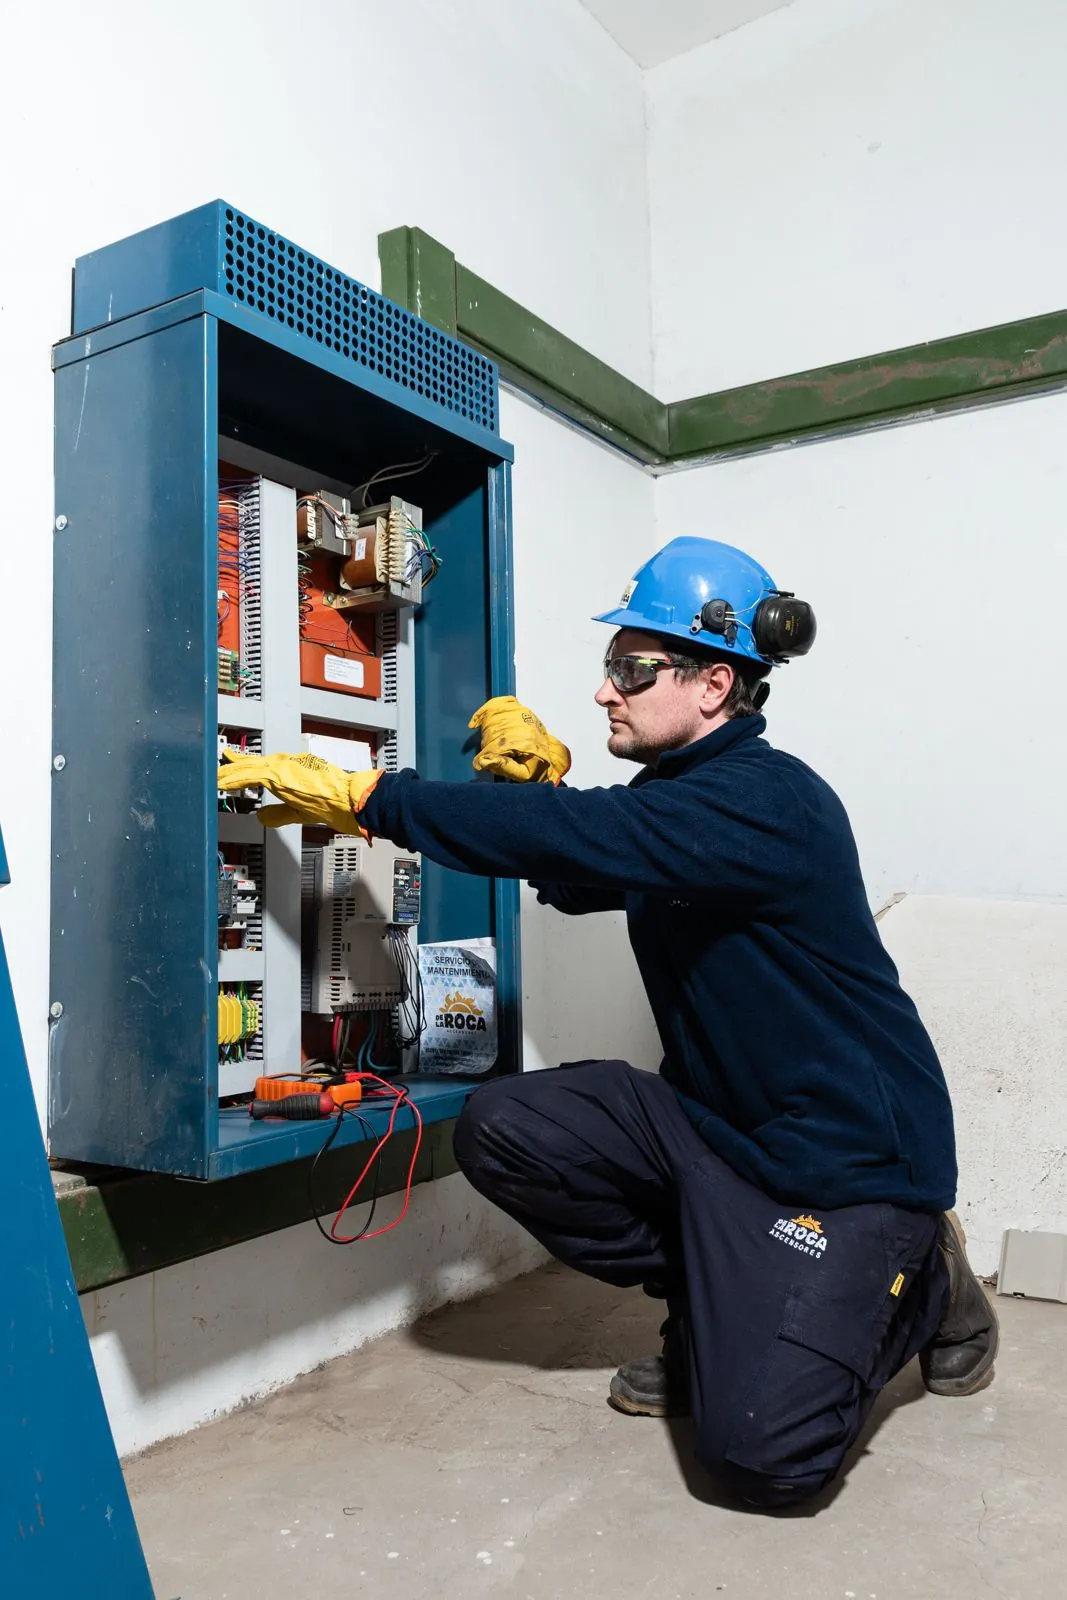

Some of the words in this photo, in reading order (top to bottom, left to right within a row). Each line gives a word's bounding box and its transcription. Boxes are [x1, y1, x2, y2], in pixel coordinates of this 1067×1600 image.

[435, 956, 471, 965] SERVICIO
[444, 1013, 487, 1032] ROCA
[769, 1229, 822, 1259] ASCENSORES
[783, 1221, 828, 1251] ROCA
